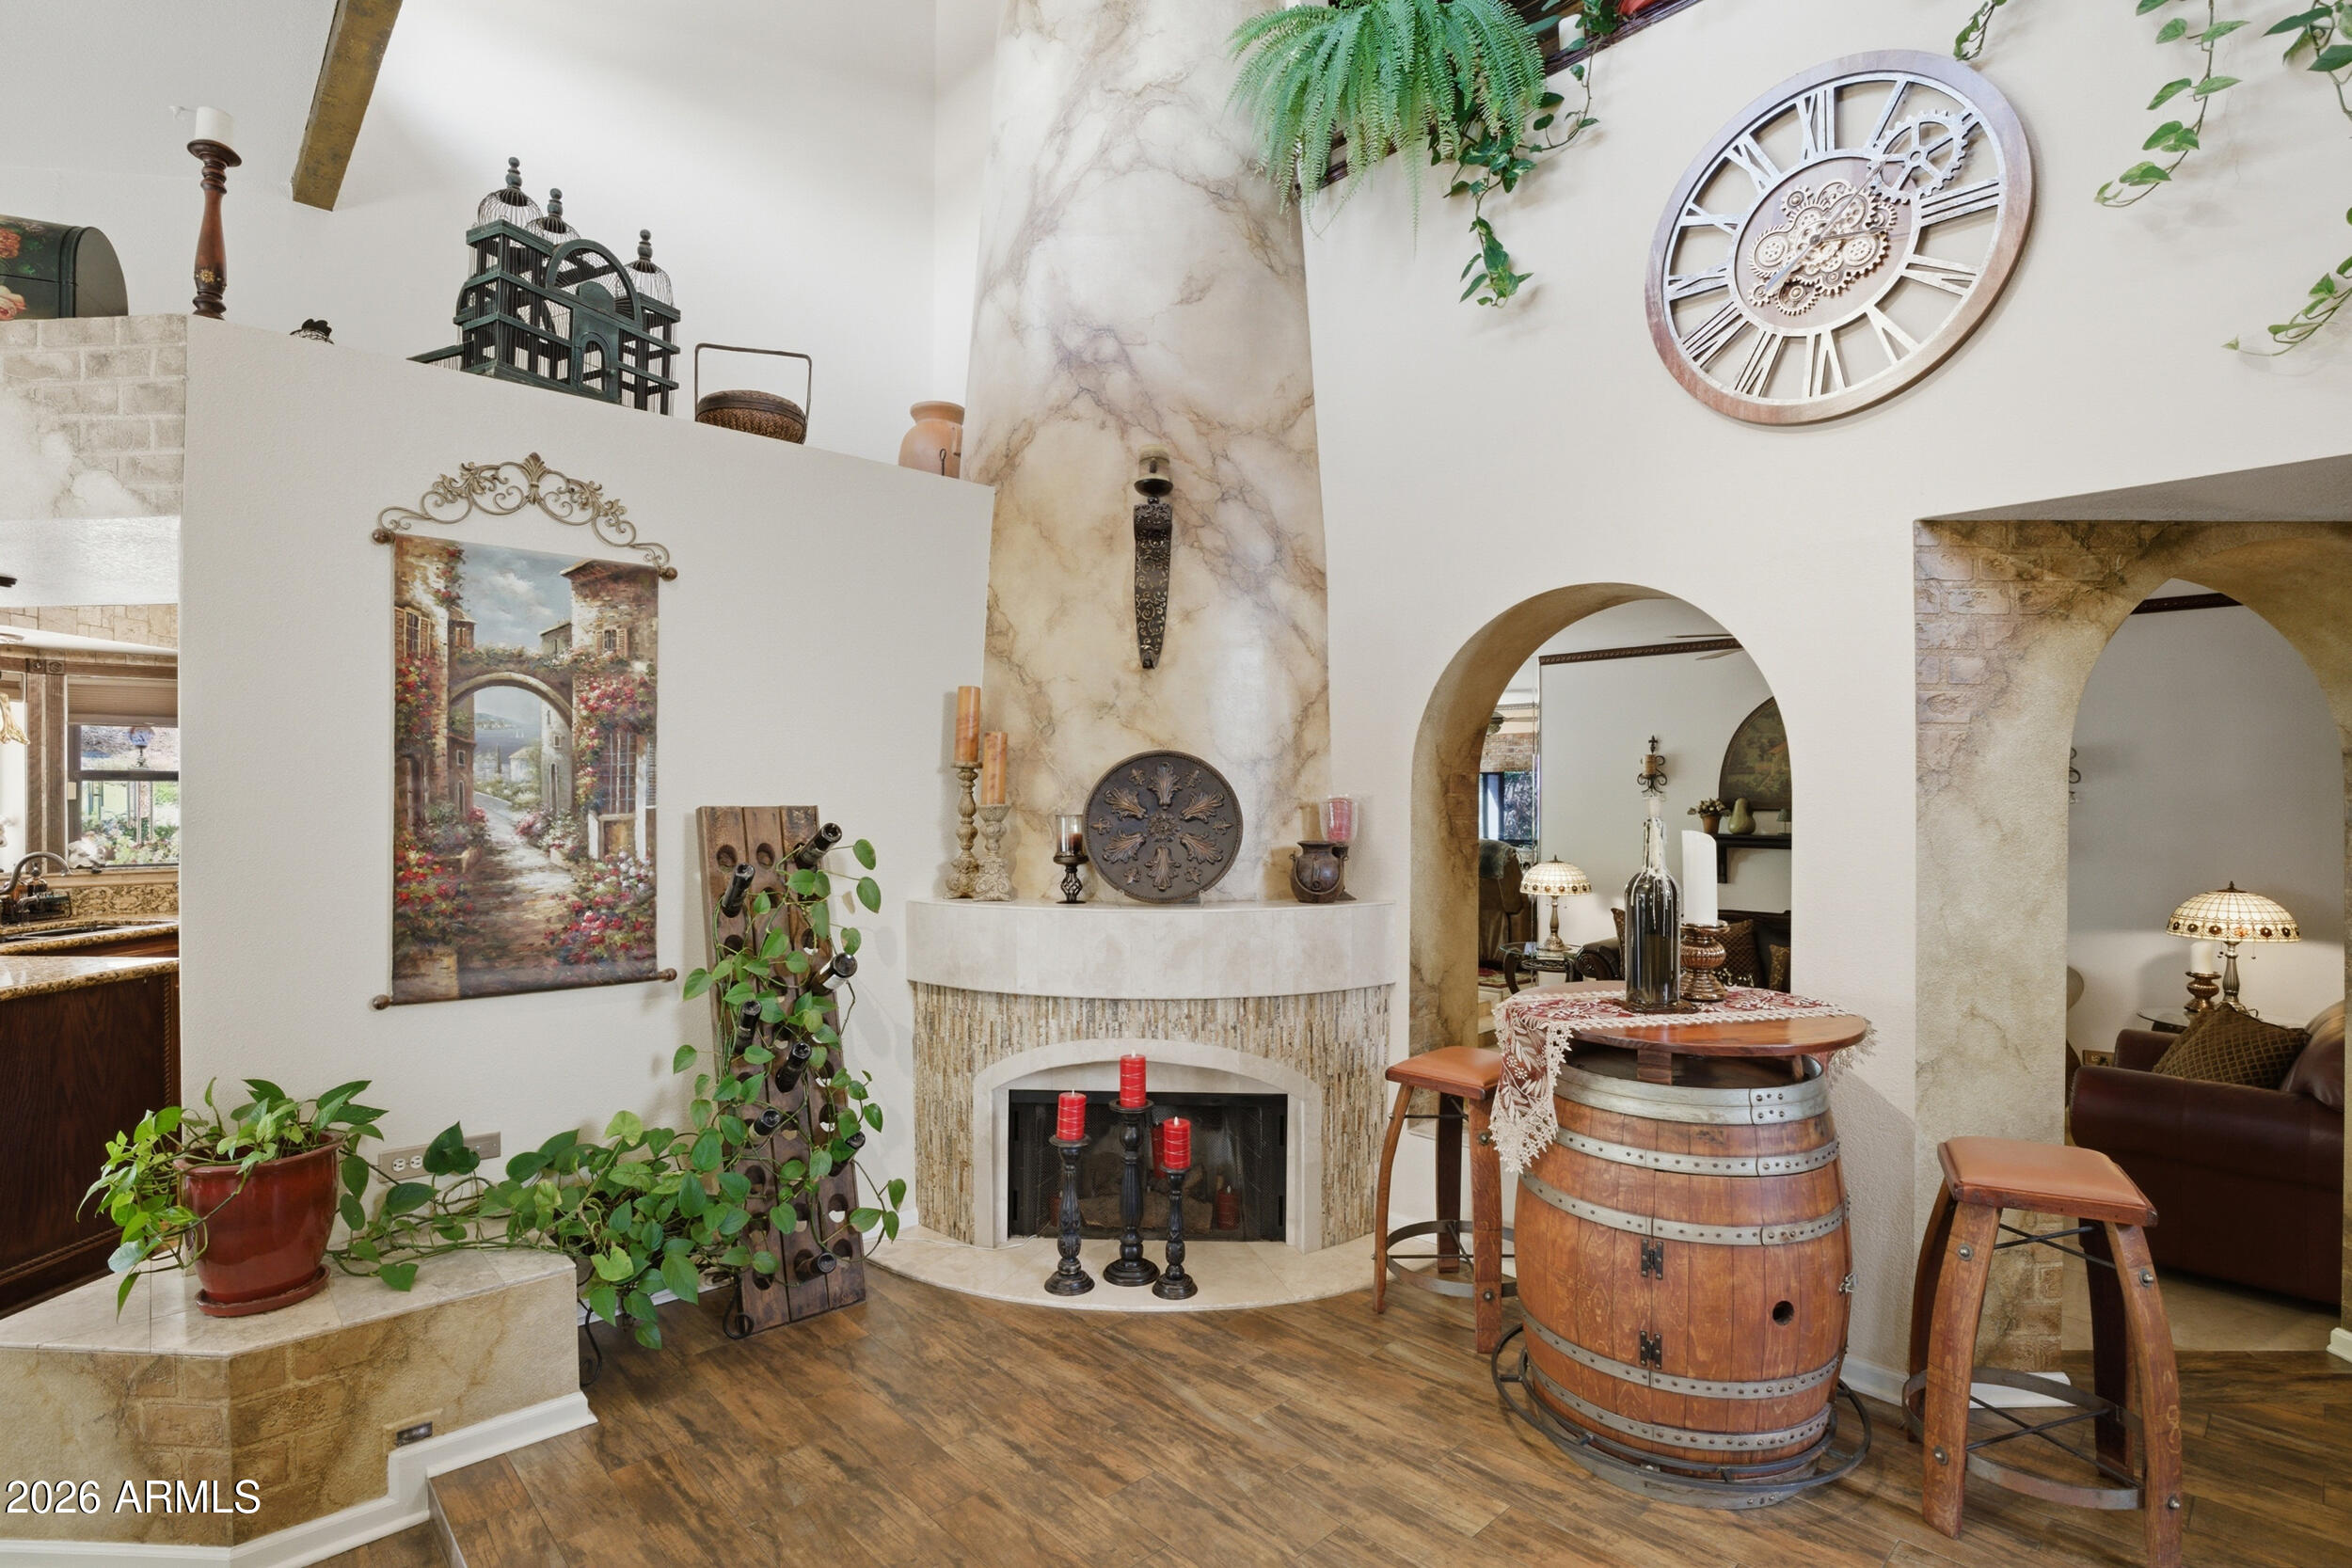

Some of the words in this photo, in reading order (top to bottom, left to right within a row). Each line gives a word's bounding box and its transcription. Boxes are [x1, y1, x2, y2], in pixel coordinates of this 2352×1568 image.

[1795, 86, 1836, 165] XII
[1867, 79, 1908, 147] I
[1724, 132, 1784, 193] XI
[1678, 200, 1741, 236] X
[1918, 178, 2000, 227] III
[1666, 263, 1731, 302] IX
[1902, 253, 1978, 297] IV
[1678, 298, 1750, 372] VIII
[1732, 328, 1785, 400] VII
[1802, 329, 1847, 400] VI
[1864, 301, 1922, 366] V
